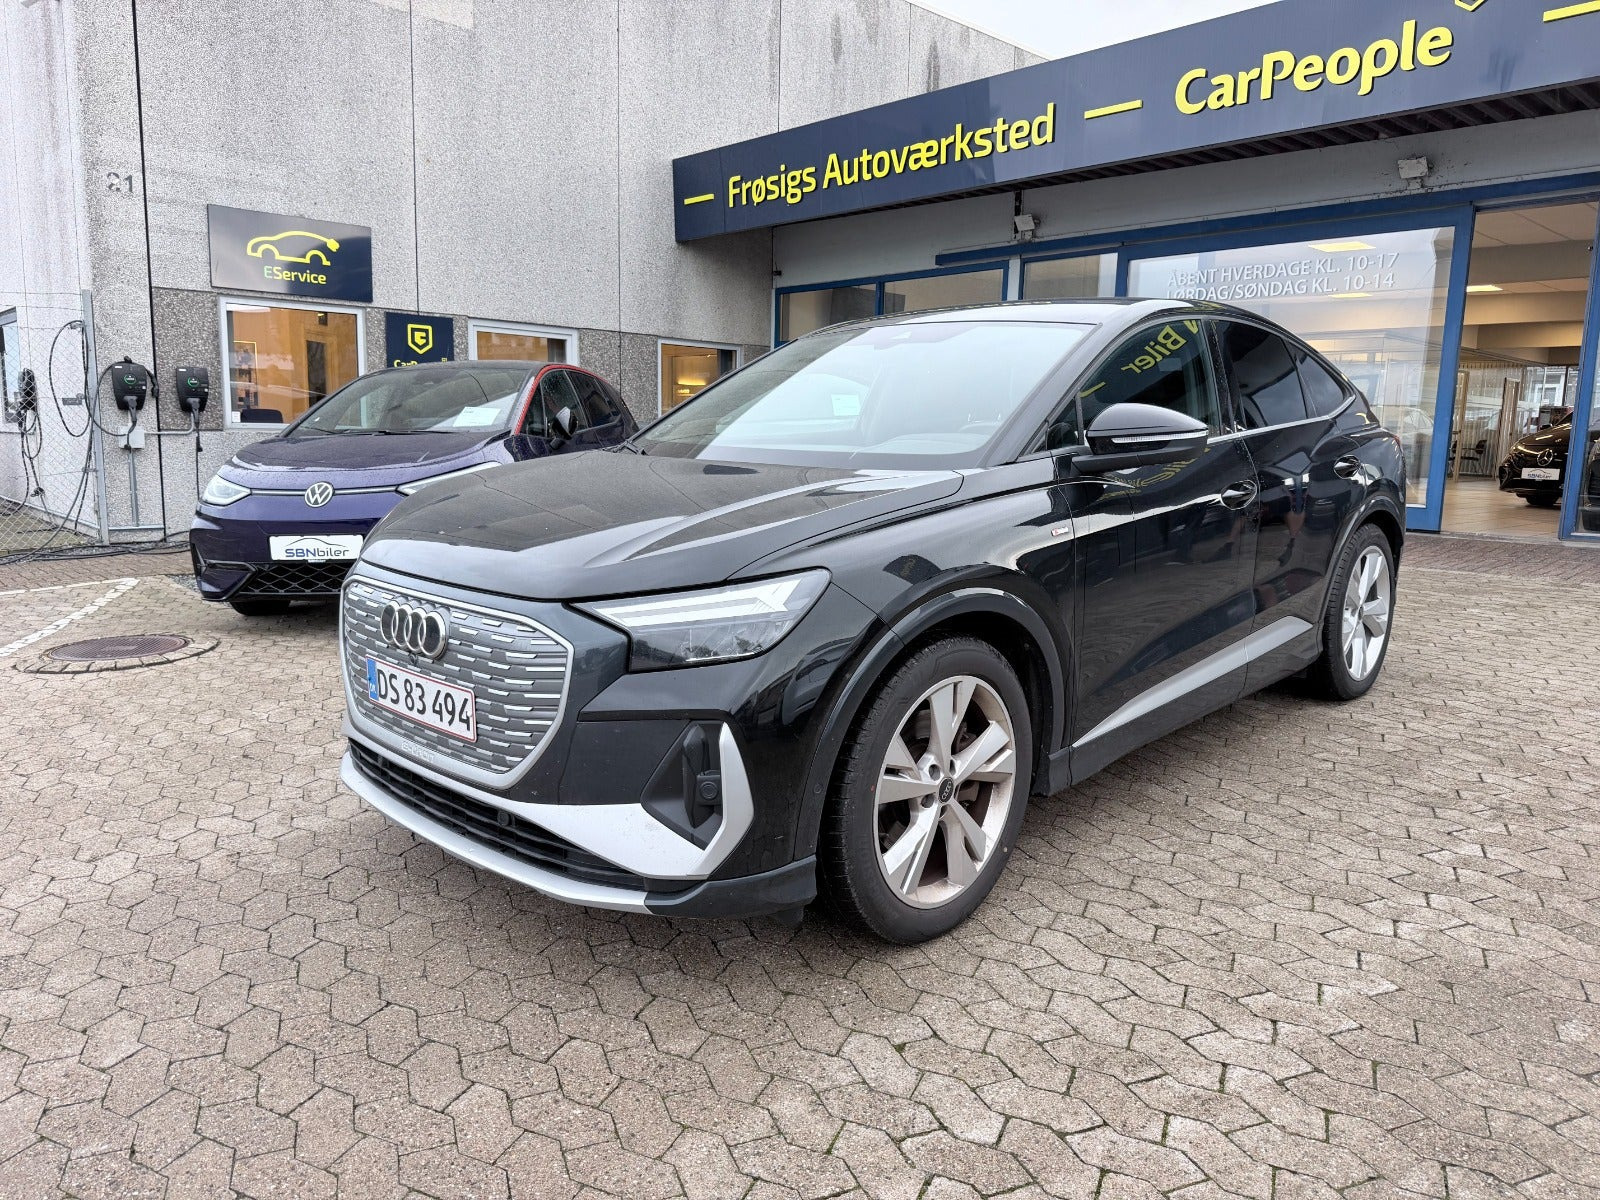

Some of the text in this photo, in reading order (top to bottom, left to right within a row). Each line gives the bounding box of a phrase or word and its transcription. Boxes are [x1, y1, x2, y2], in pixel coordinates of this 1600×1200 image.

[1175, 21, 1454, 116] CarPeople
[728, 103, 1056, 208] Frøsigs Autoværksted
[263, 265, 327, 285] EService
[1168, 252, 1400, 287] ÅBENT HVERDAGE KL. 10-17
[1311, 276, 1338, 294] KL.
[1344, 272, 1396, 290] 10-14
[284, 547, 350, 558] SBNbiler
[377, 668, 471, 731] DS 83 494
